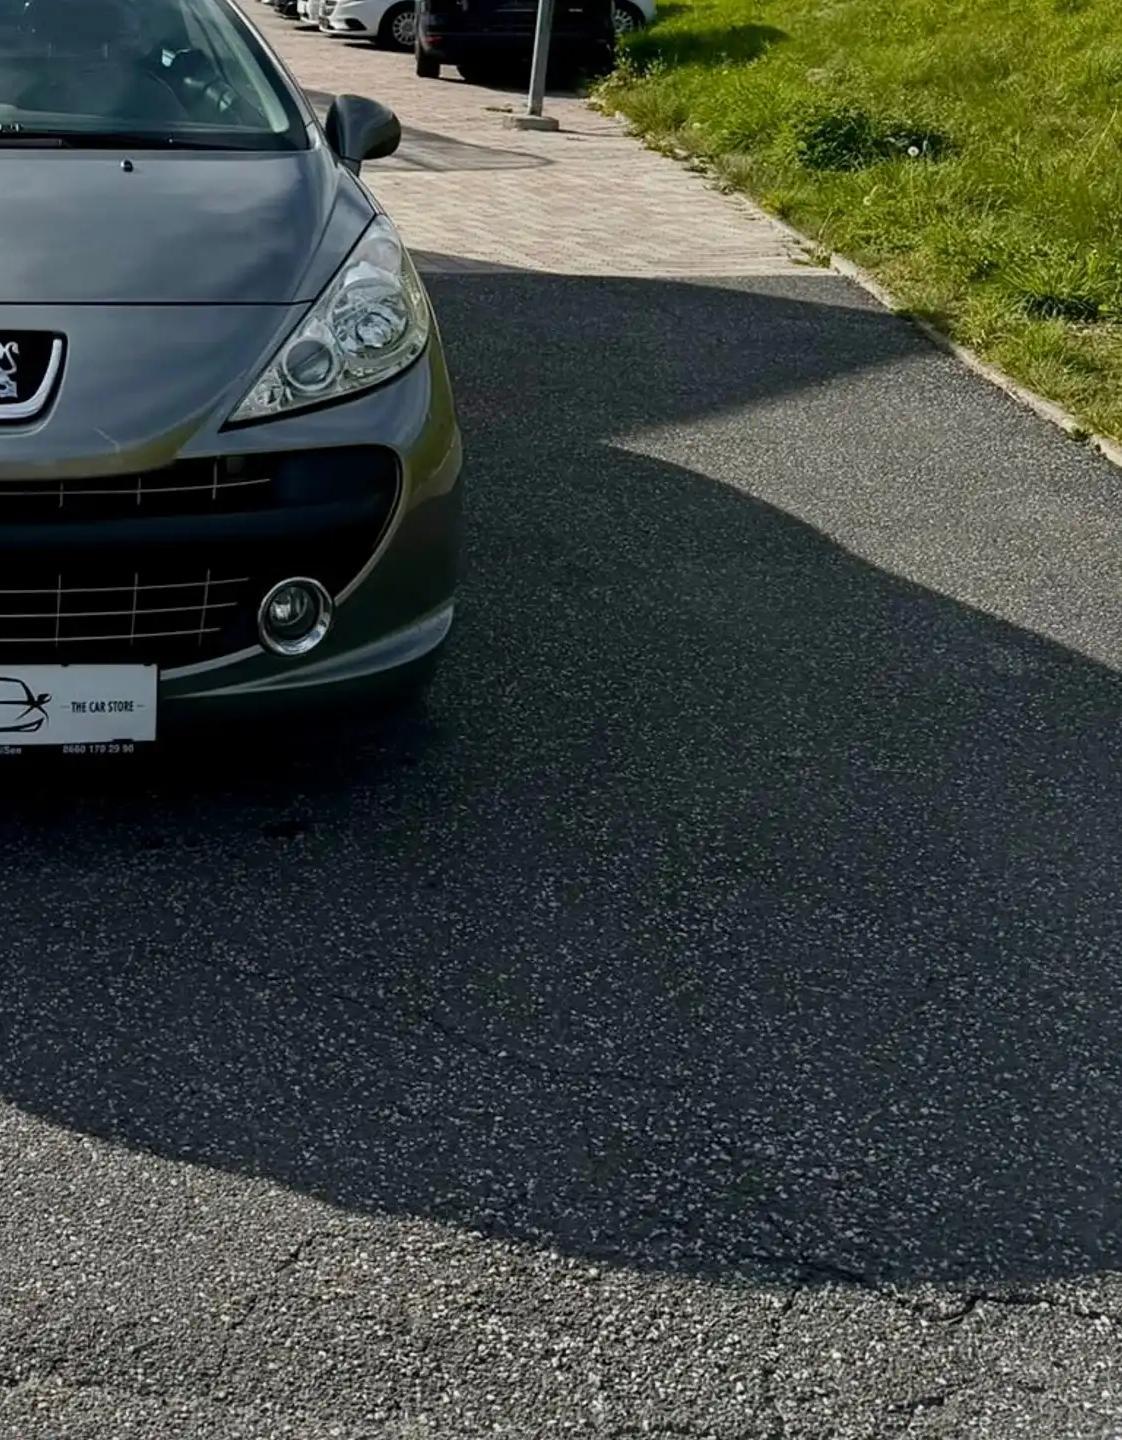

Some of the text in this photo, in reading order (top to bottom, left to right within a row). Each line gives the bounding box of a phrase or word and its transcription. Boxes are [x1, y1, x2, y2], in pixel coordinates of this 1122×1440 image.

[71, 701, 135, 713] THE CAR STORE
